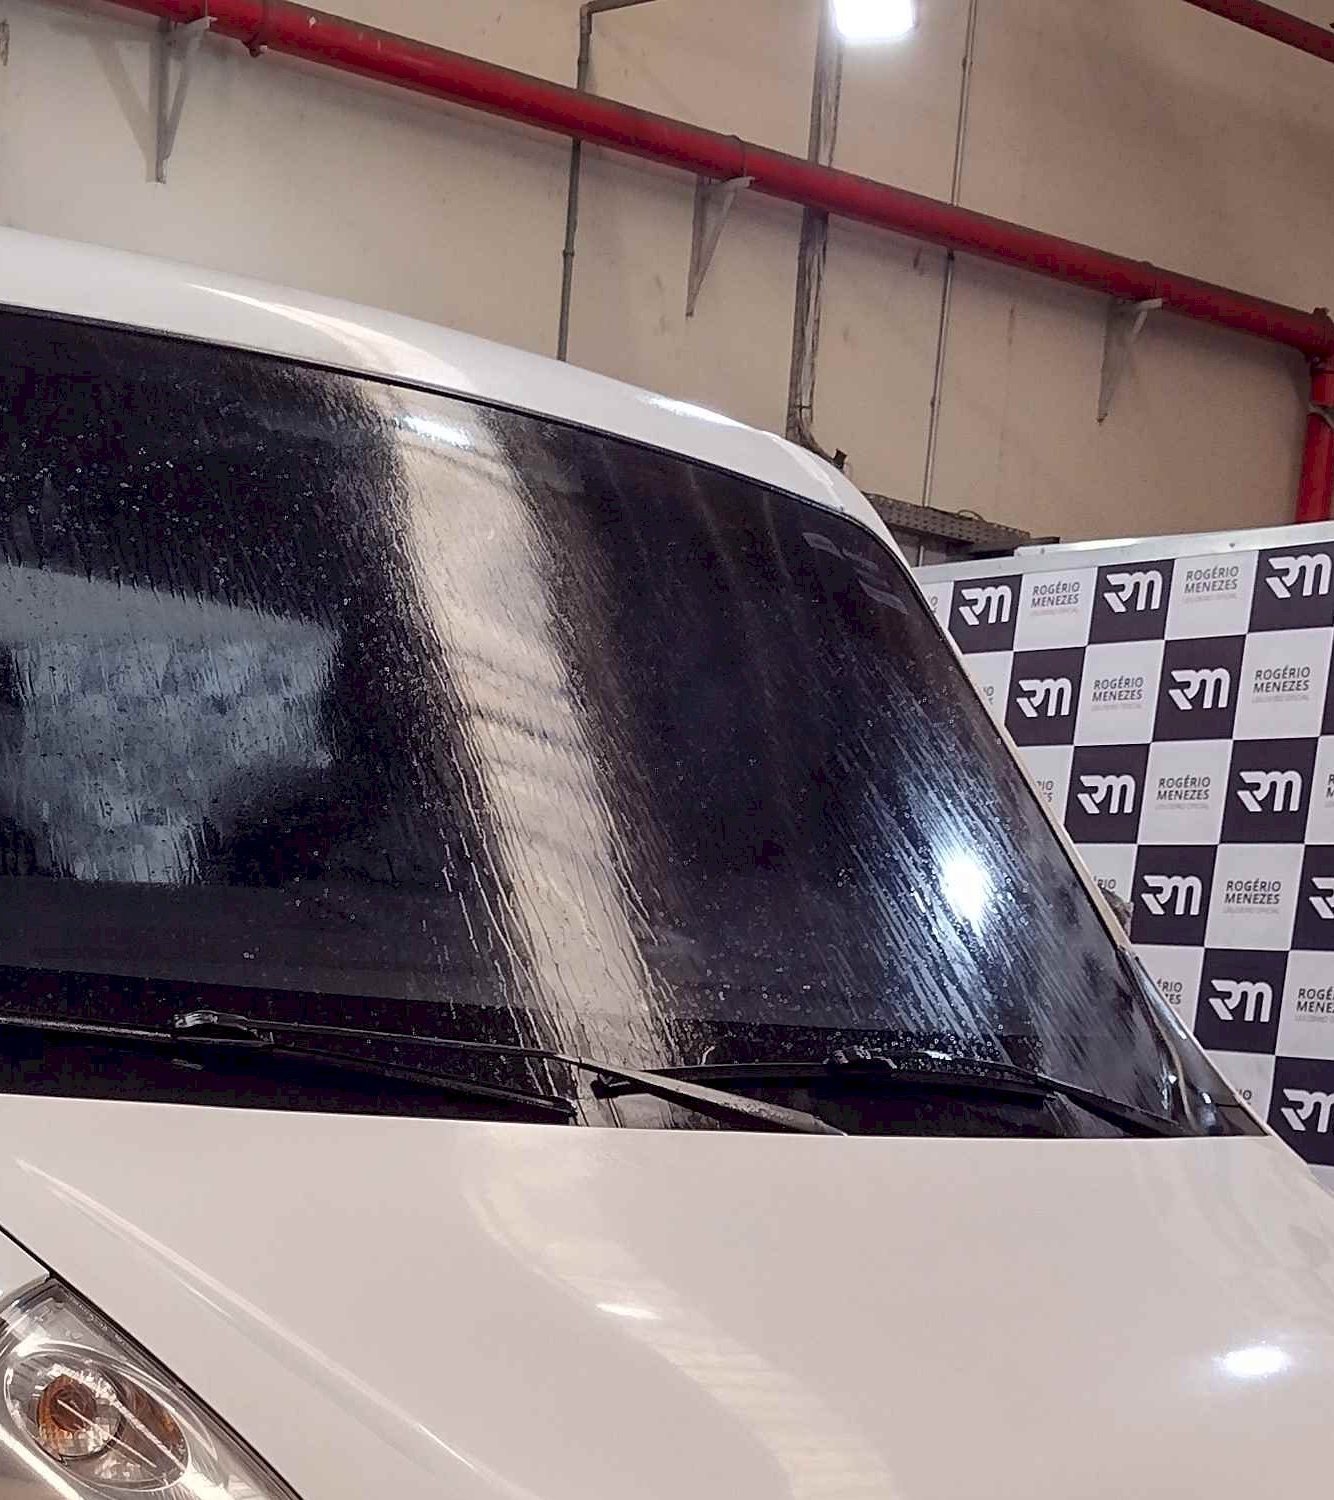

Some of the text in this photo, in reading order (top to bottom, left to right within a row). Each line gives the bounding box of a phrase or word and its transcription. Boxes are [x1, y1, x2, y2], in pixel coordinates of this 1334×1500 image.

[1184, 566, 1240, 582] ROGÉRIO
[1184, 578, 1238, 593] MENEZES
[1255, 665, 1310, 681] ROGÉRIO
[1253, 680, 1310, 693] MENEZES
